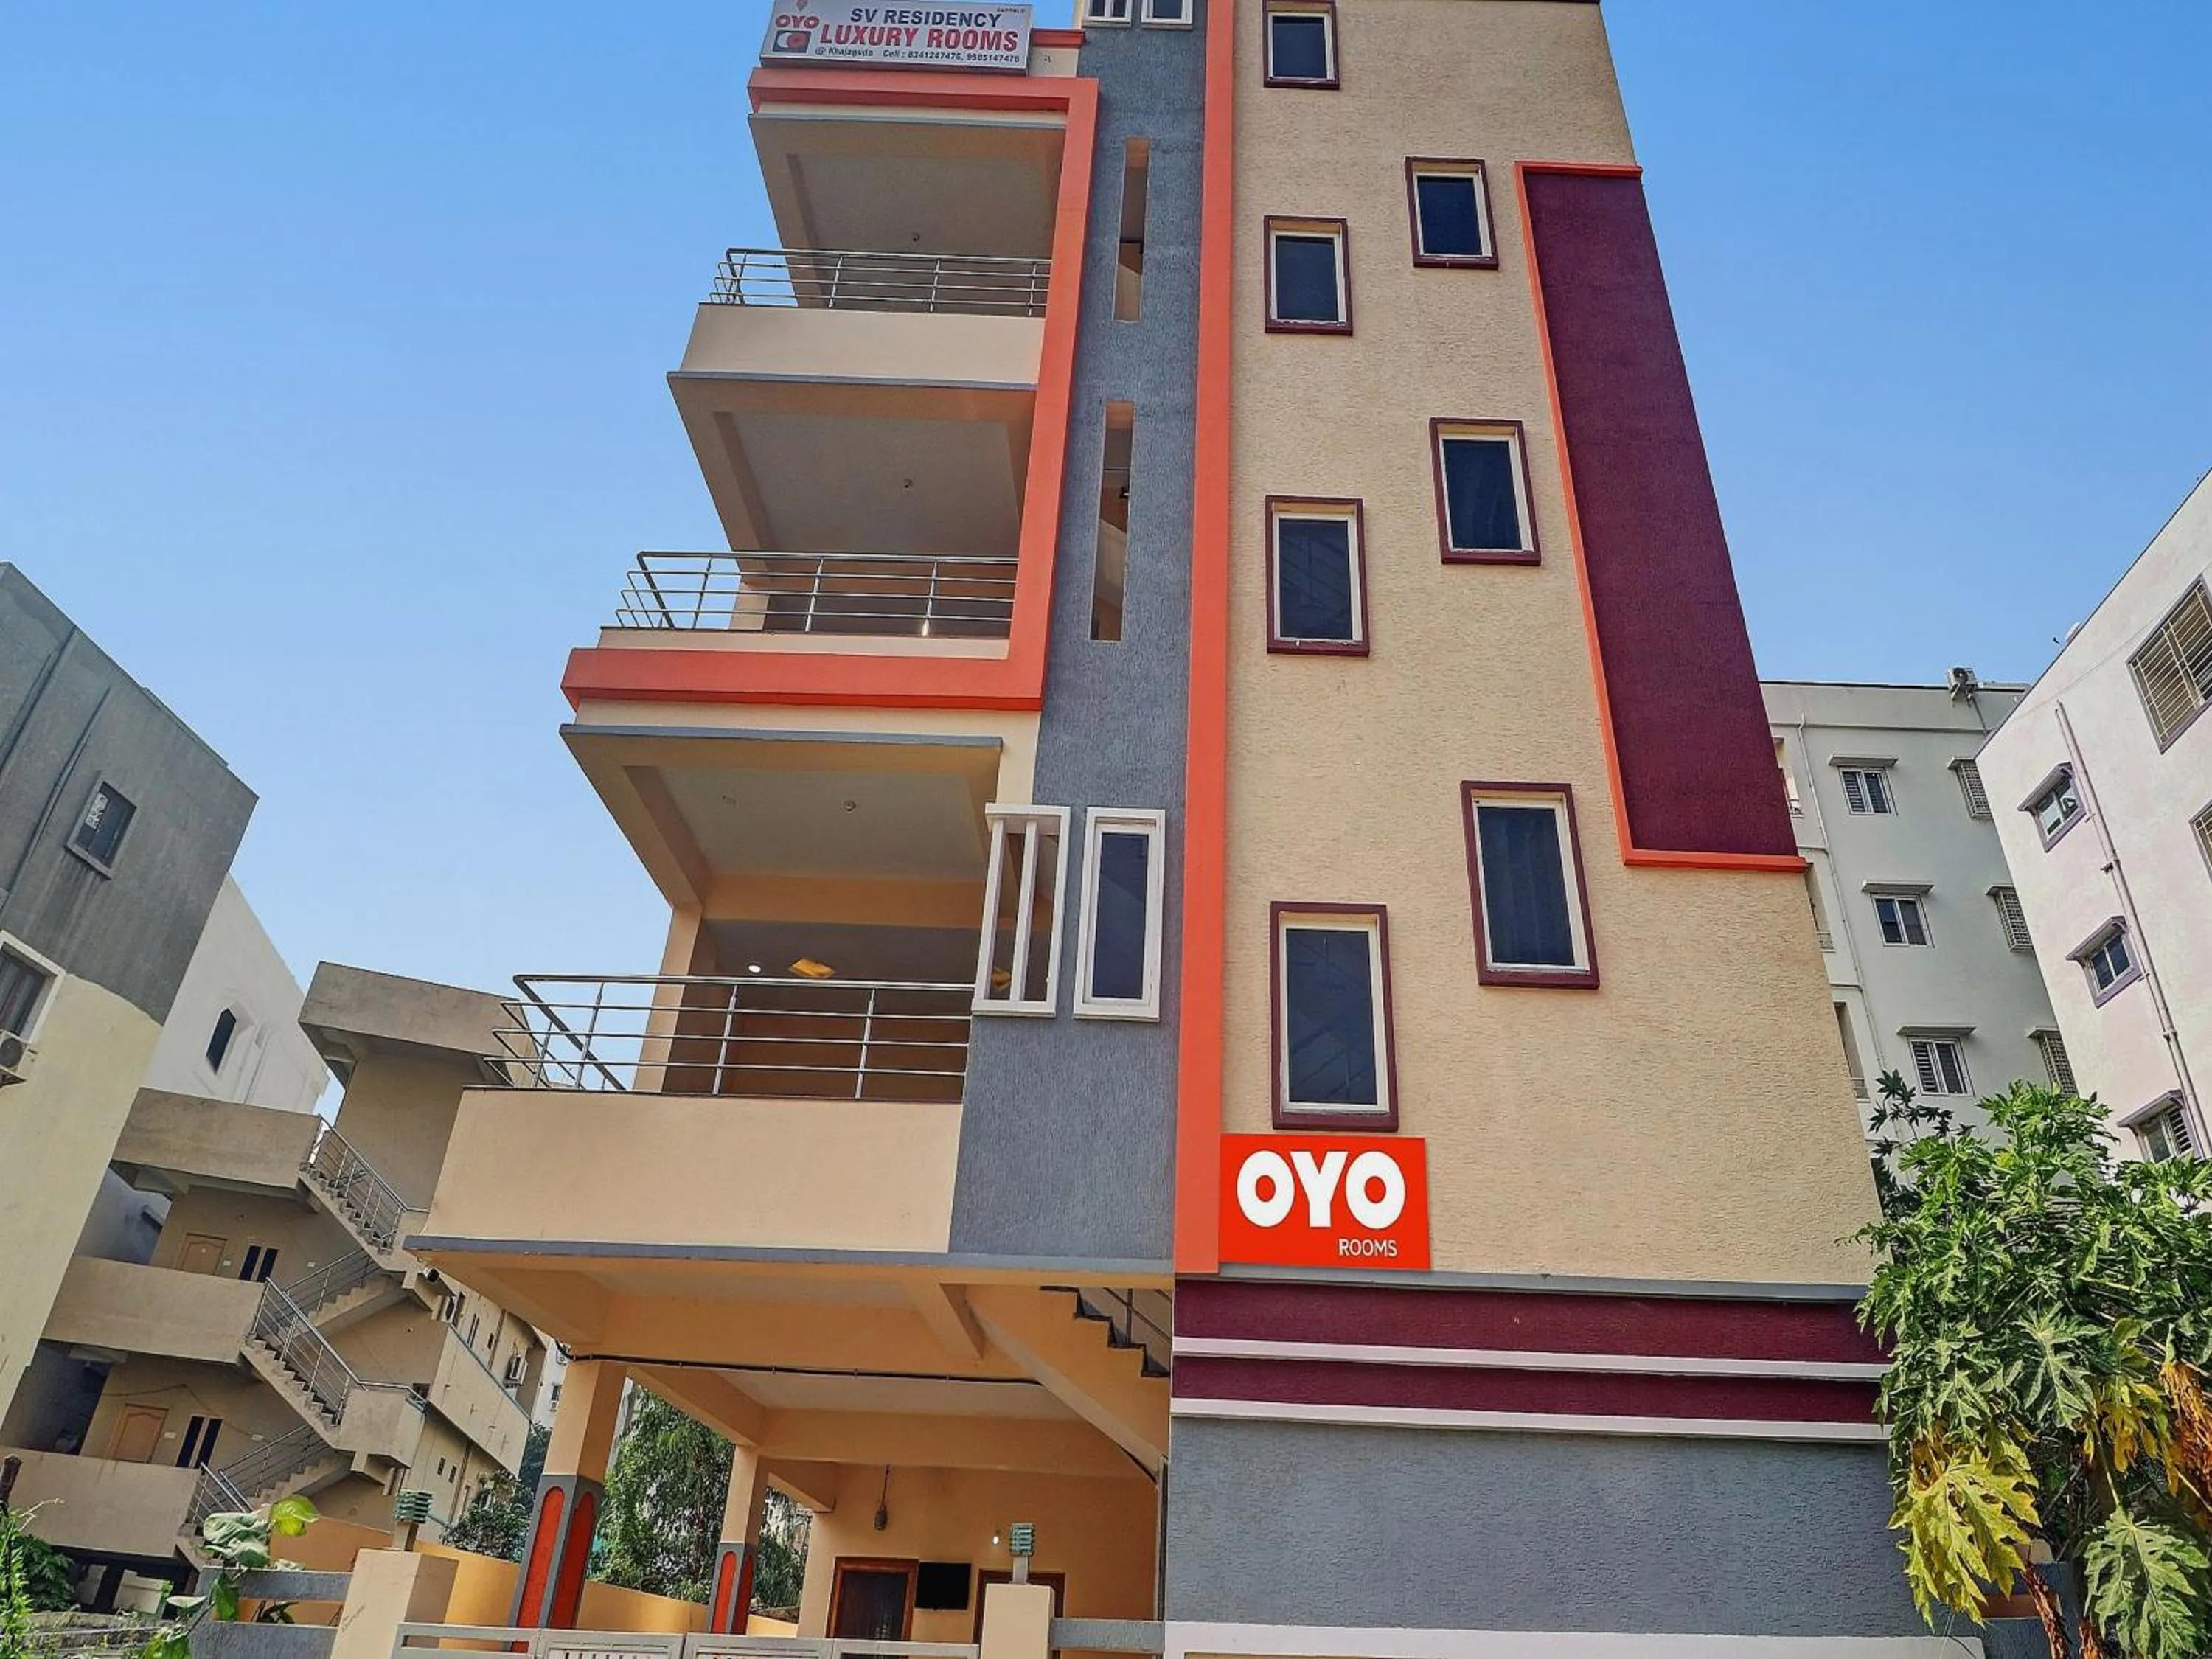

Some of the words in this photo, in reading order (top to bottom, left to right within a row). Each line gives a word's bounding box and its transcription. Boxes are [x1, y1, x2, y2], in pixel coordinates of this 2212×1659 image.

[776, 15, 820, 28] OYO
[850, 8, 877, 23] SV
[883, 10, 1002, 27] RESIDENCY
[820, 24, 919, 47] LUXURY
[926, 28, 1018, 51] ROOMS
[1237, 1150, 1406, 1229] OYO
[1338, 1238, 1398, 1257] ROOMS
